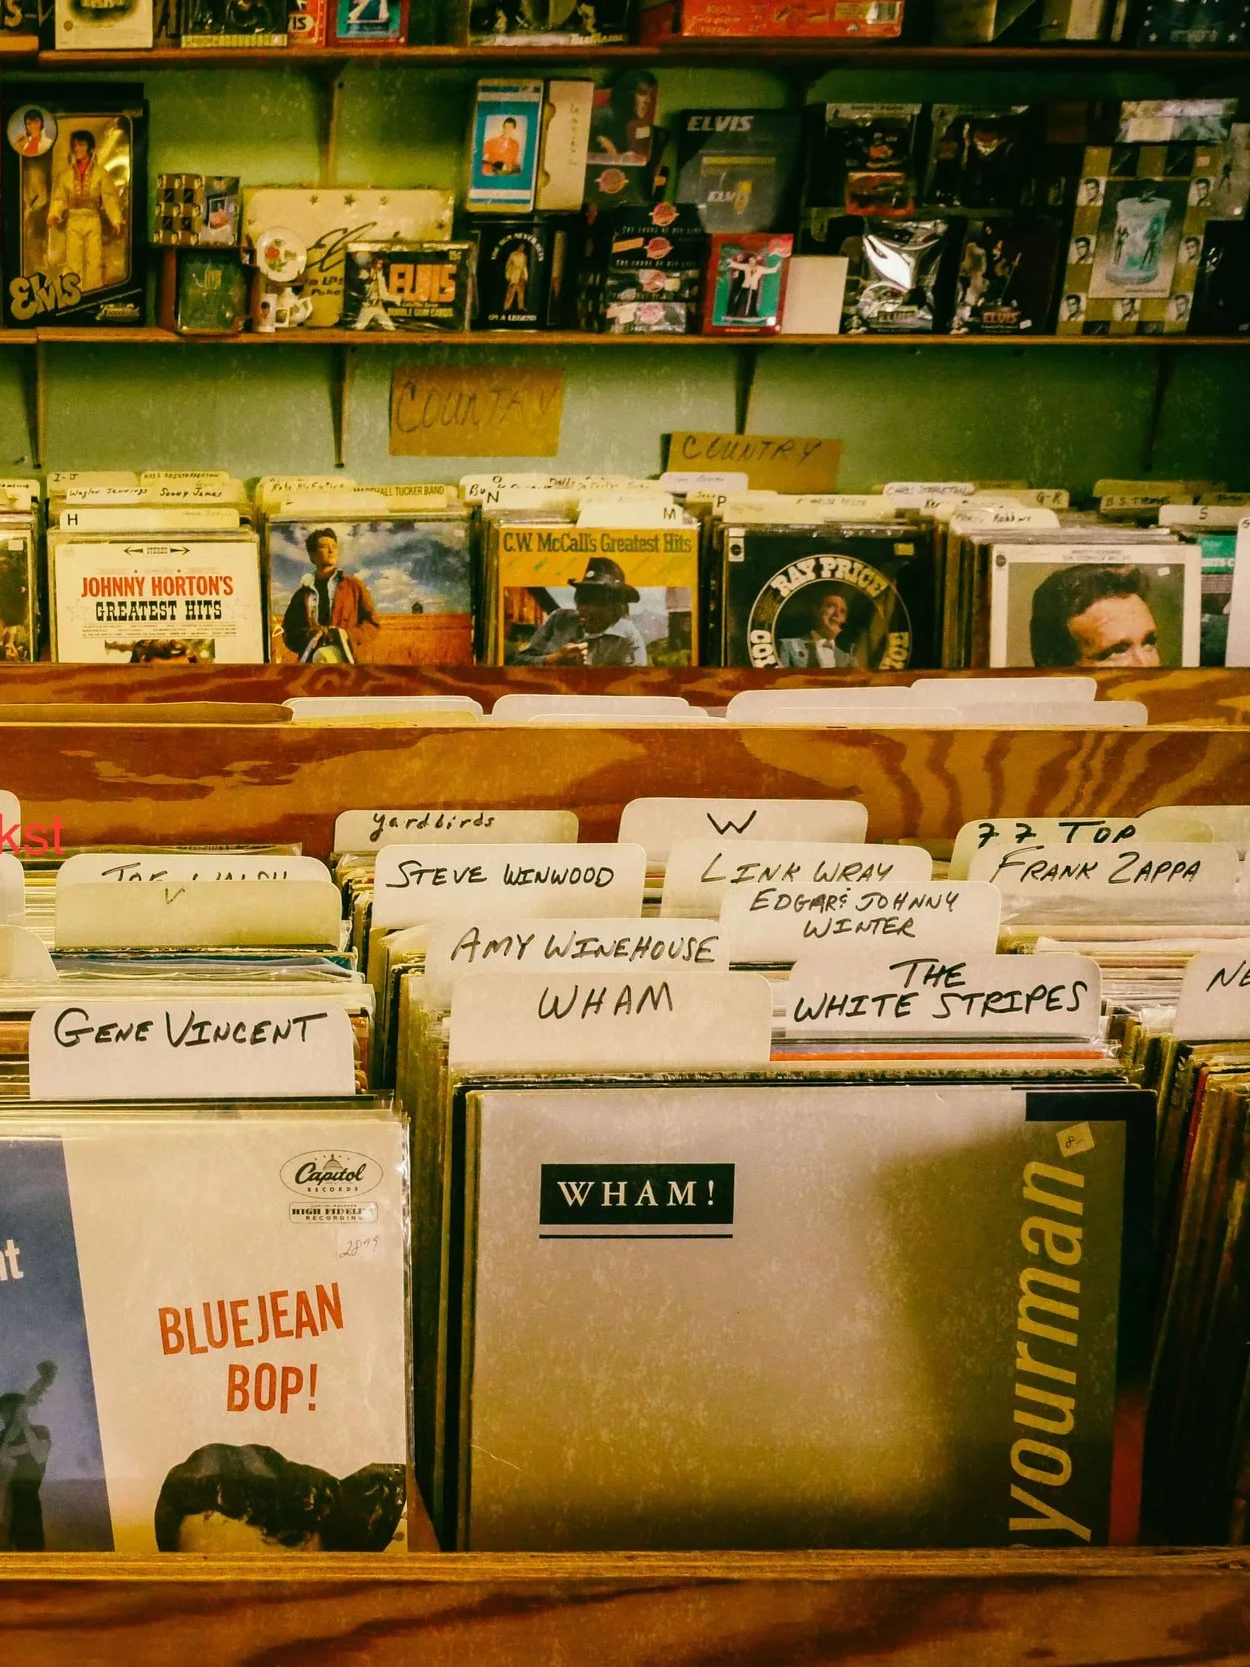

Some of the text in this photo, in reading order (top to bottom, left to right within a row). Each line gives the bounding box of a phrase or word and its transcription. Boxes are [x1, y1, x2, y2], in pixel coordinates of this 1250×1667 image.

[687, 115, 754, 132] ELVIS
[389, 263, 458, 303] ELVIS
[9, 272, 82, 321] Elvis
[396, 378, 561, 433] COUNTRY
[682, 437, 822, 463] COUNTRY
[69, 487, 149, 500] Waylon Jennings
[160, 487, 190, 499] Sonny
[395, 486, 446, 496] TUCKER BAND
[487, 491, 501, 504] N
[717, 495, 728, 508] P
[67, 513, 79, 526] H
[663, 507, 676, 521] M
[1199, 507, 1209, 520] S
[537, 532, 597, 553] McCall's
[600, 532, 660, 553] Greatest
[663, 532, 692, 553] Hits
[81, 575, 234, 598] JOHNNY HORTON'S
[769, 557, 890, 598] RAY PRICE
[95, 600, 222, 622] GREATEST HITS
[369, 811, 496, 843] yardbirds
[706, 809, 758, 836] W
[1057, 820, 1137, 844] TOP
[385, 859, 616, 889] STEVE WINWOOD
[700, 851, 895, 884] LINK WRAY
[995, 845, 1205, 884] FRANK ZAPPA
[855, 890, 961, 913] JOHNNY
[803, 915, 917, 939] WINTER
[449, 926, 721, 965] AMY WINEHOUSE
[889, 957, 967, 989] THE
[536, 980, 675, 1021] WHAM
[792, 979, 1089, 1025] WHITE STRIPES
[53, 1006, 330, 1050] GENE VINCENT
[294, 1161, 367, 1186] Capitol
[556, 1177, 719, 1210] WHAM!
[292, 1208, 374, 1216] HIGH FIDELI
[226, 1362, 320, 1414] BOP!
